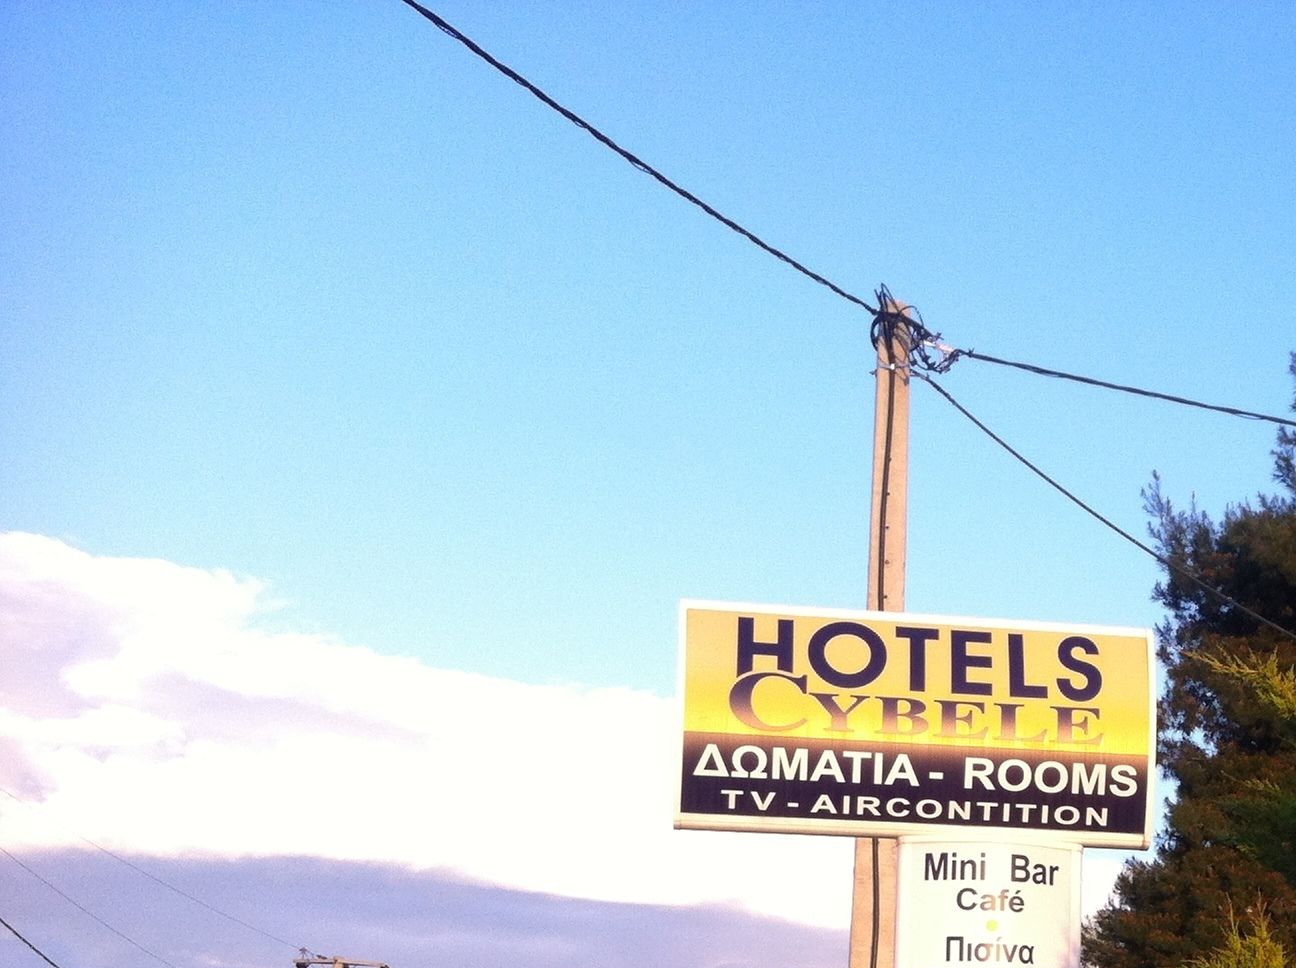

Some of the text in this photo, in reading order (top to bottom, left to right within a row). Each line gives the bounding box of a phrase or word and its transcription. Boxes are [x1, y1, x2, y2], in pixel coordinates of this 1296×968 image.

[736, 616, 1103, 702] HOTELS
[729, 671, 1104, 746] CYBELE
[692, 743, 920, 787] ΔΩΜΑΤΙΑ
[963, 757, 1138, 797] ROOMS
[721, 789, 776, 811] TV
[810, 794, 1109, 826] AIRCONTITION
[924, 852, 1060, 886] Mini Bar
[956, 887, 1025, 913] Café
[945, 936, 1035, 965] Πισίνα
